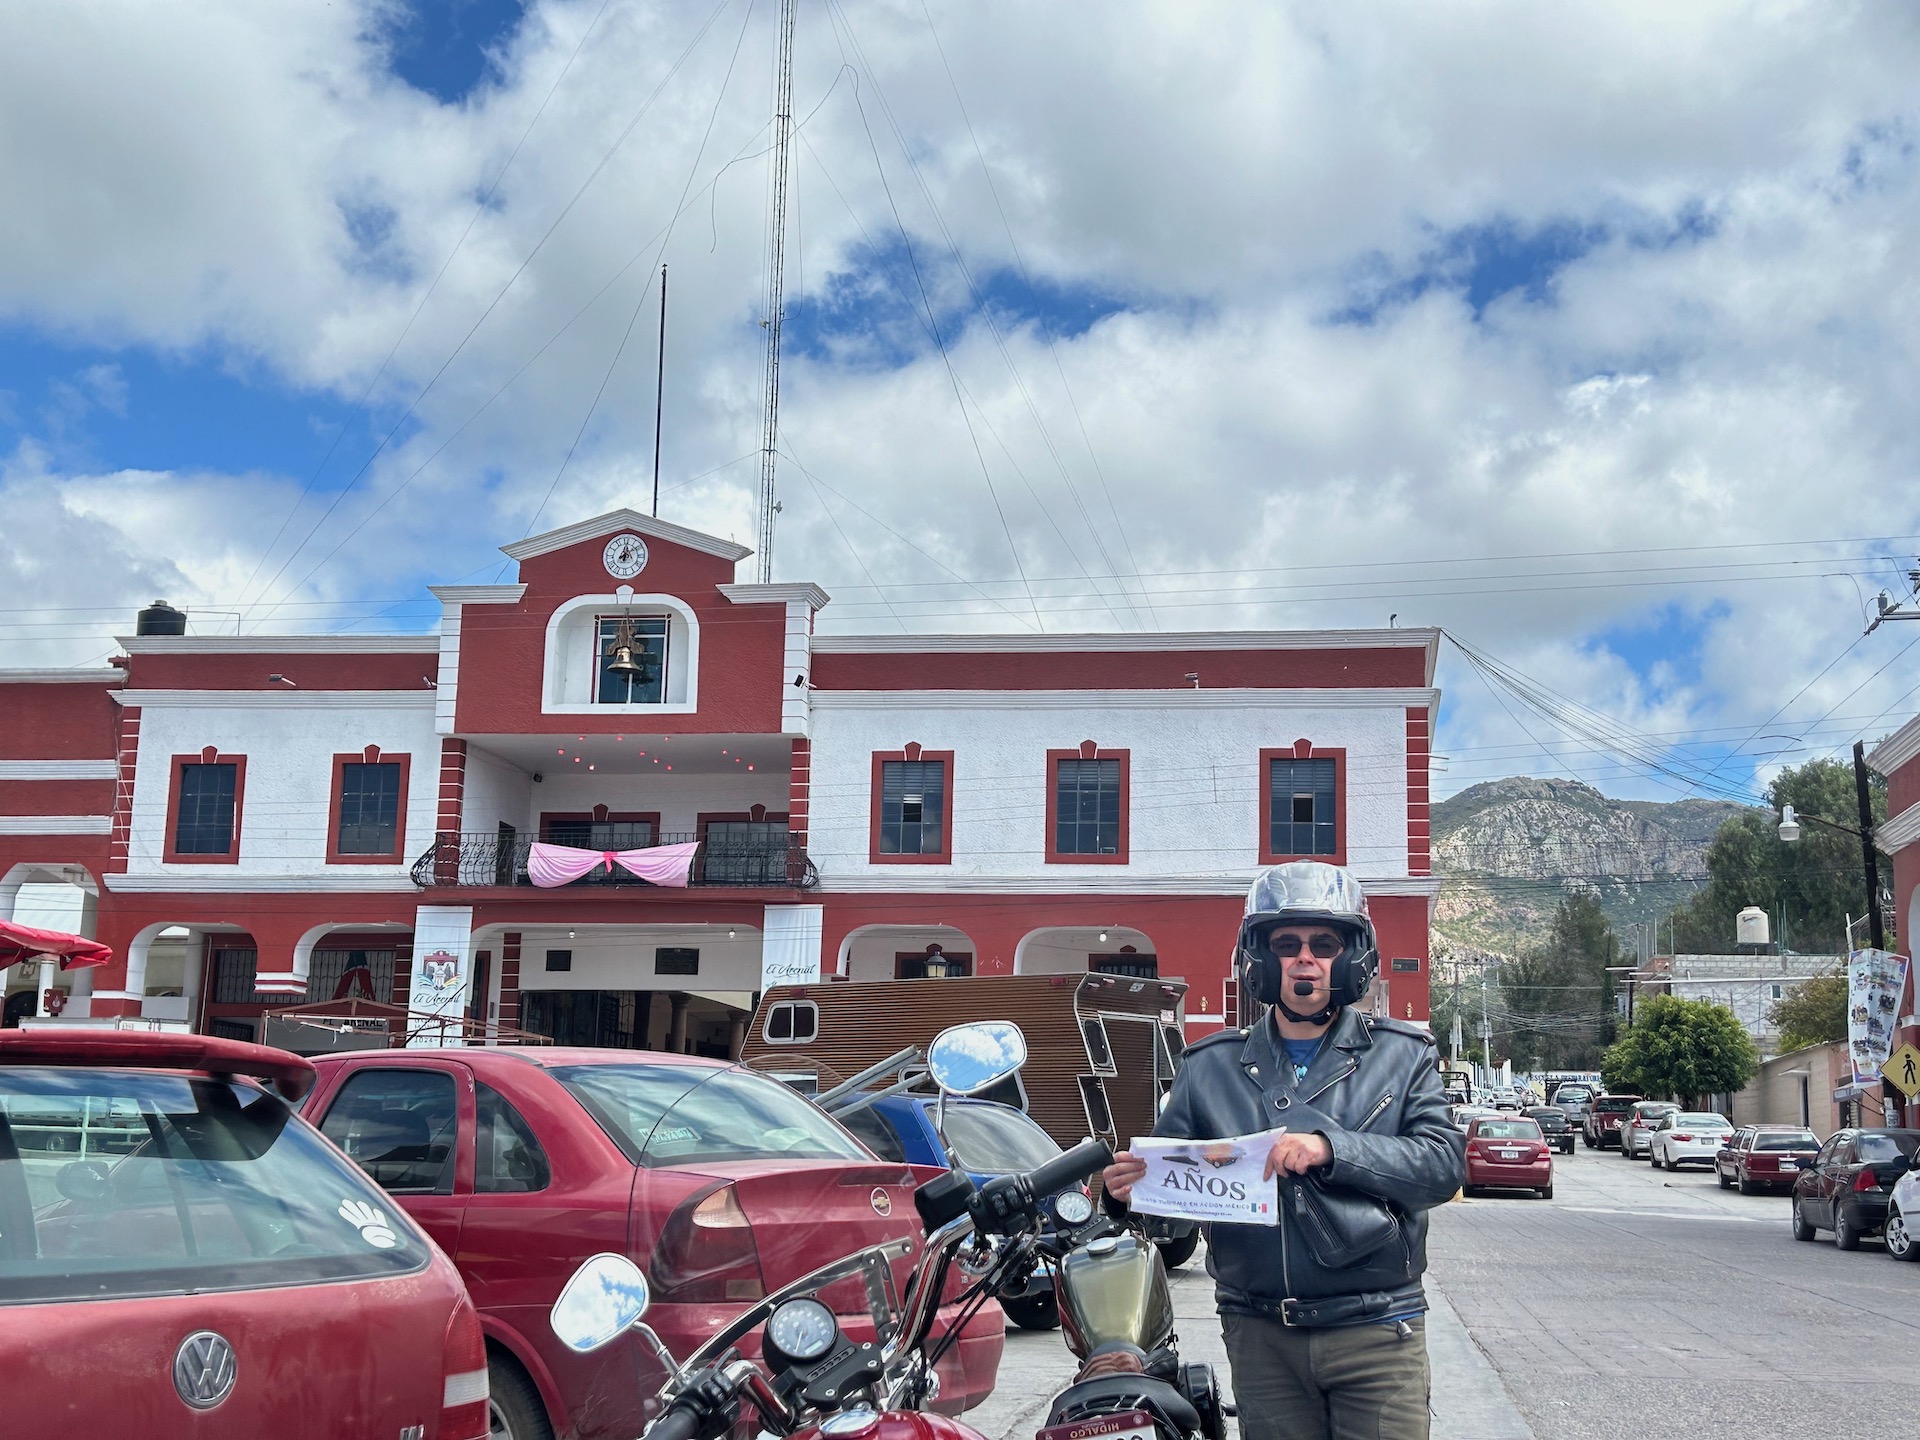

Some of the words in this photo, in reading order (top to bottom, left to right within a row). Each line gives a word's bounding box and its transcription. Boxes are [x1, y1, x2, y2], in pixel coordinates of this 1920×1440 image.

[778, 963, 816, 979] Arenal
[1160, 1167, 1246, 1201] AÑOS
[1069, 1423, 1120, 1438] HIDALGO
